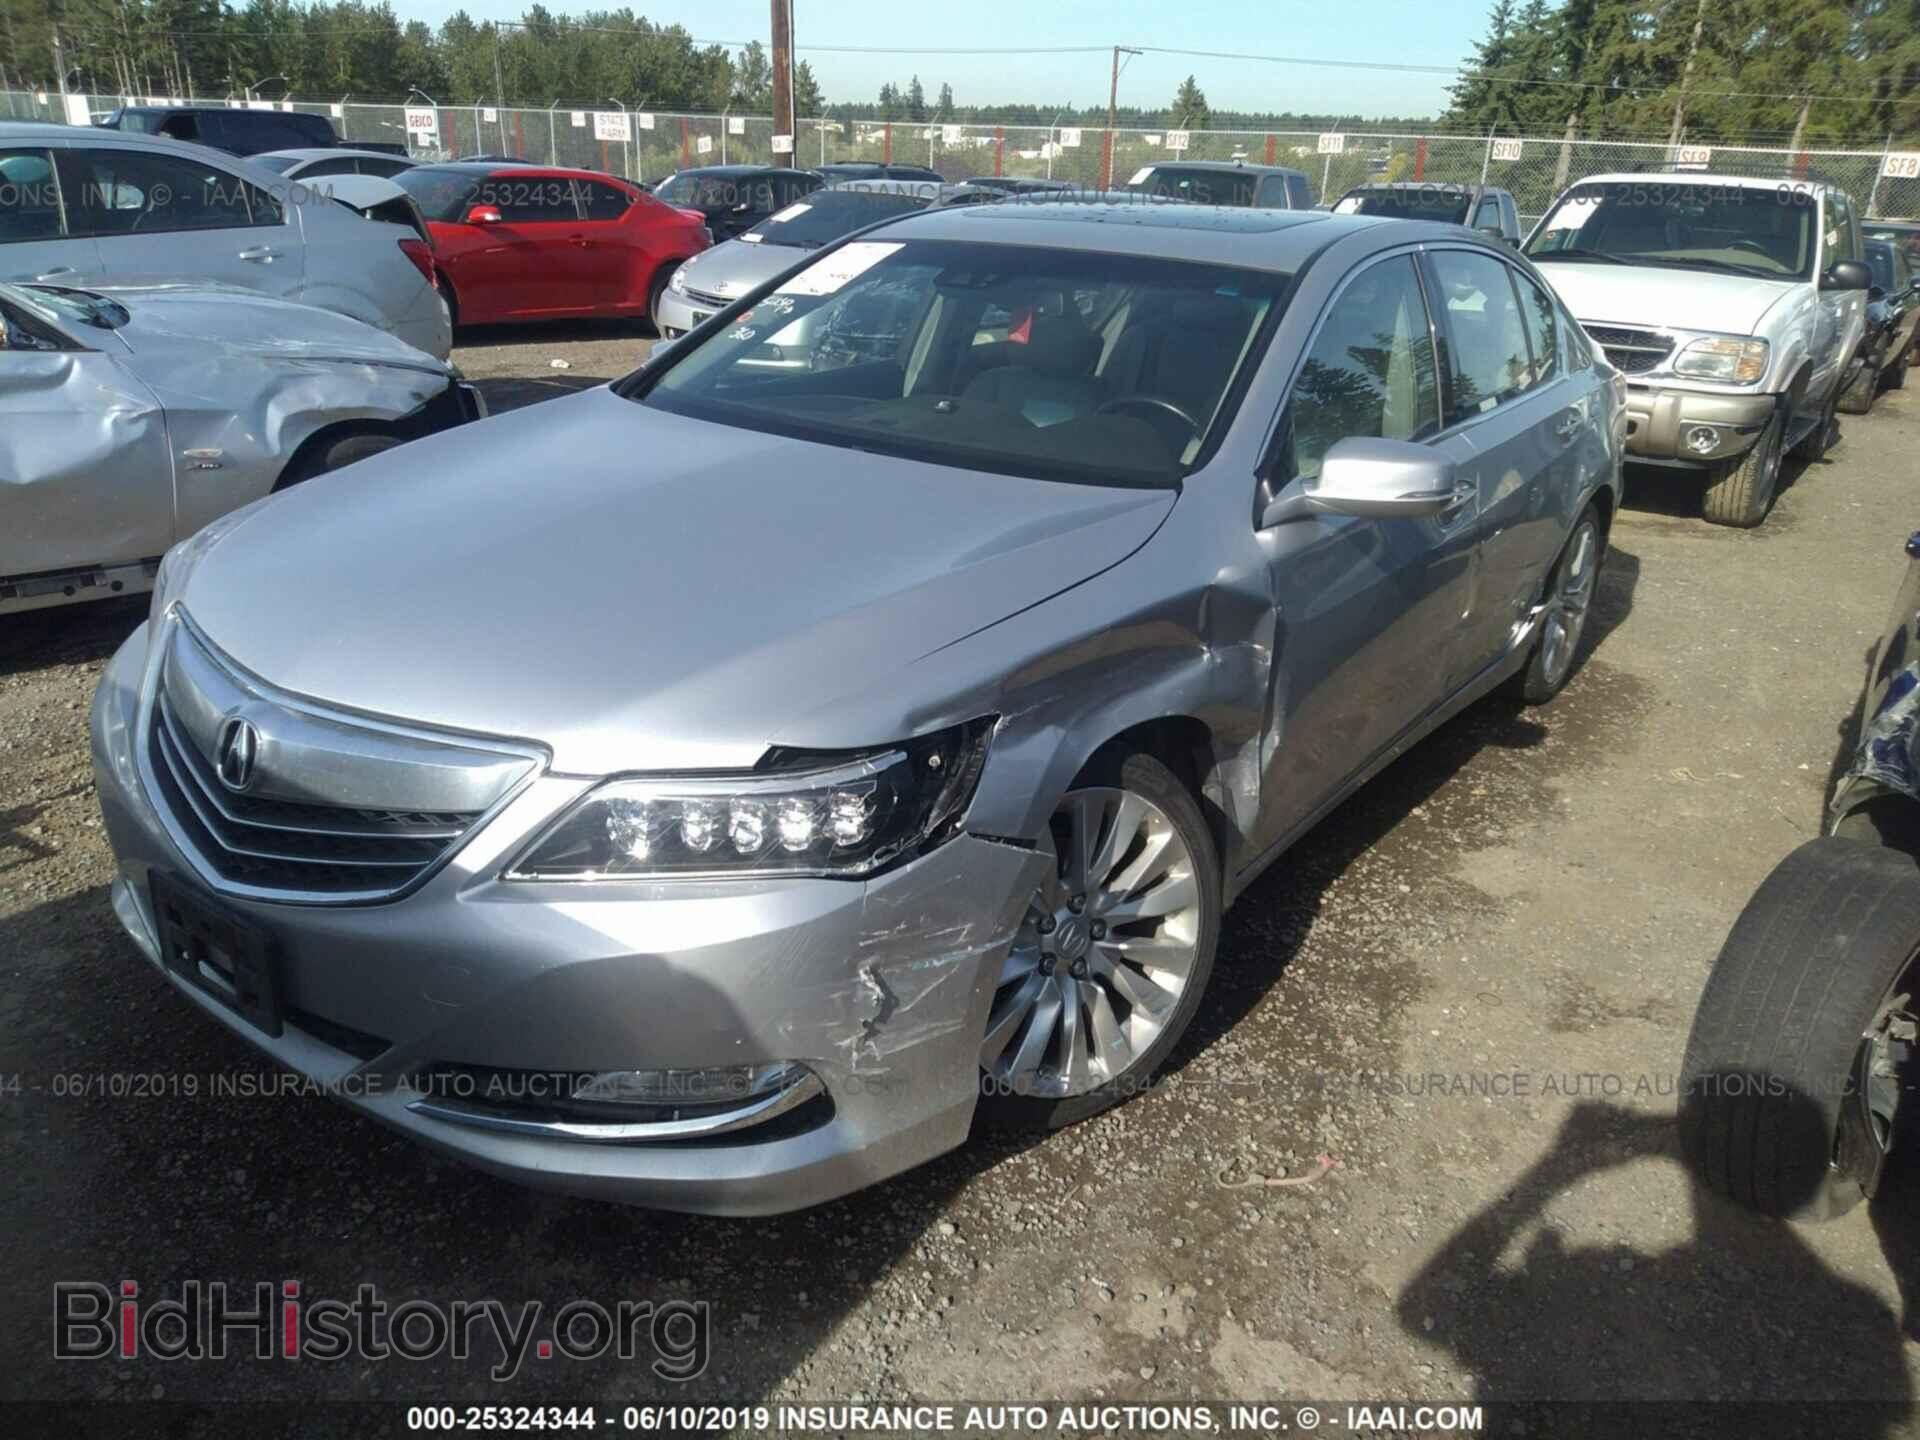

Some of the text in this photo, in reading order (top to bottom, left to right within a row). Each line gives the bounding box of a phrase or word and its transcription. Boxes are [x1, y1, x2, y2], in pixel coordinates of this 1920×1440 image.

[409, 115, 432, 128] GEICO
[1494, 143, 1520, 158] SF10
[1888, 157, 1918, 175] SF8
